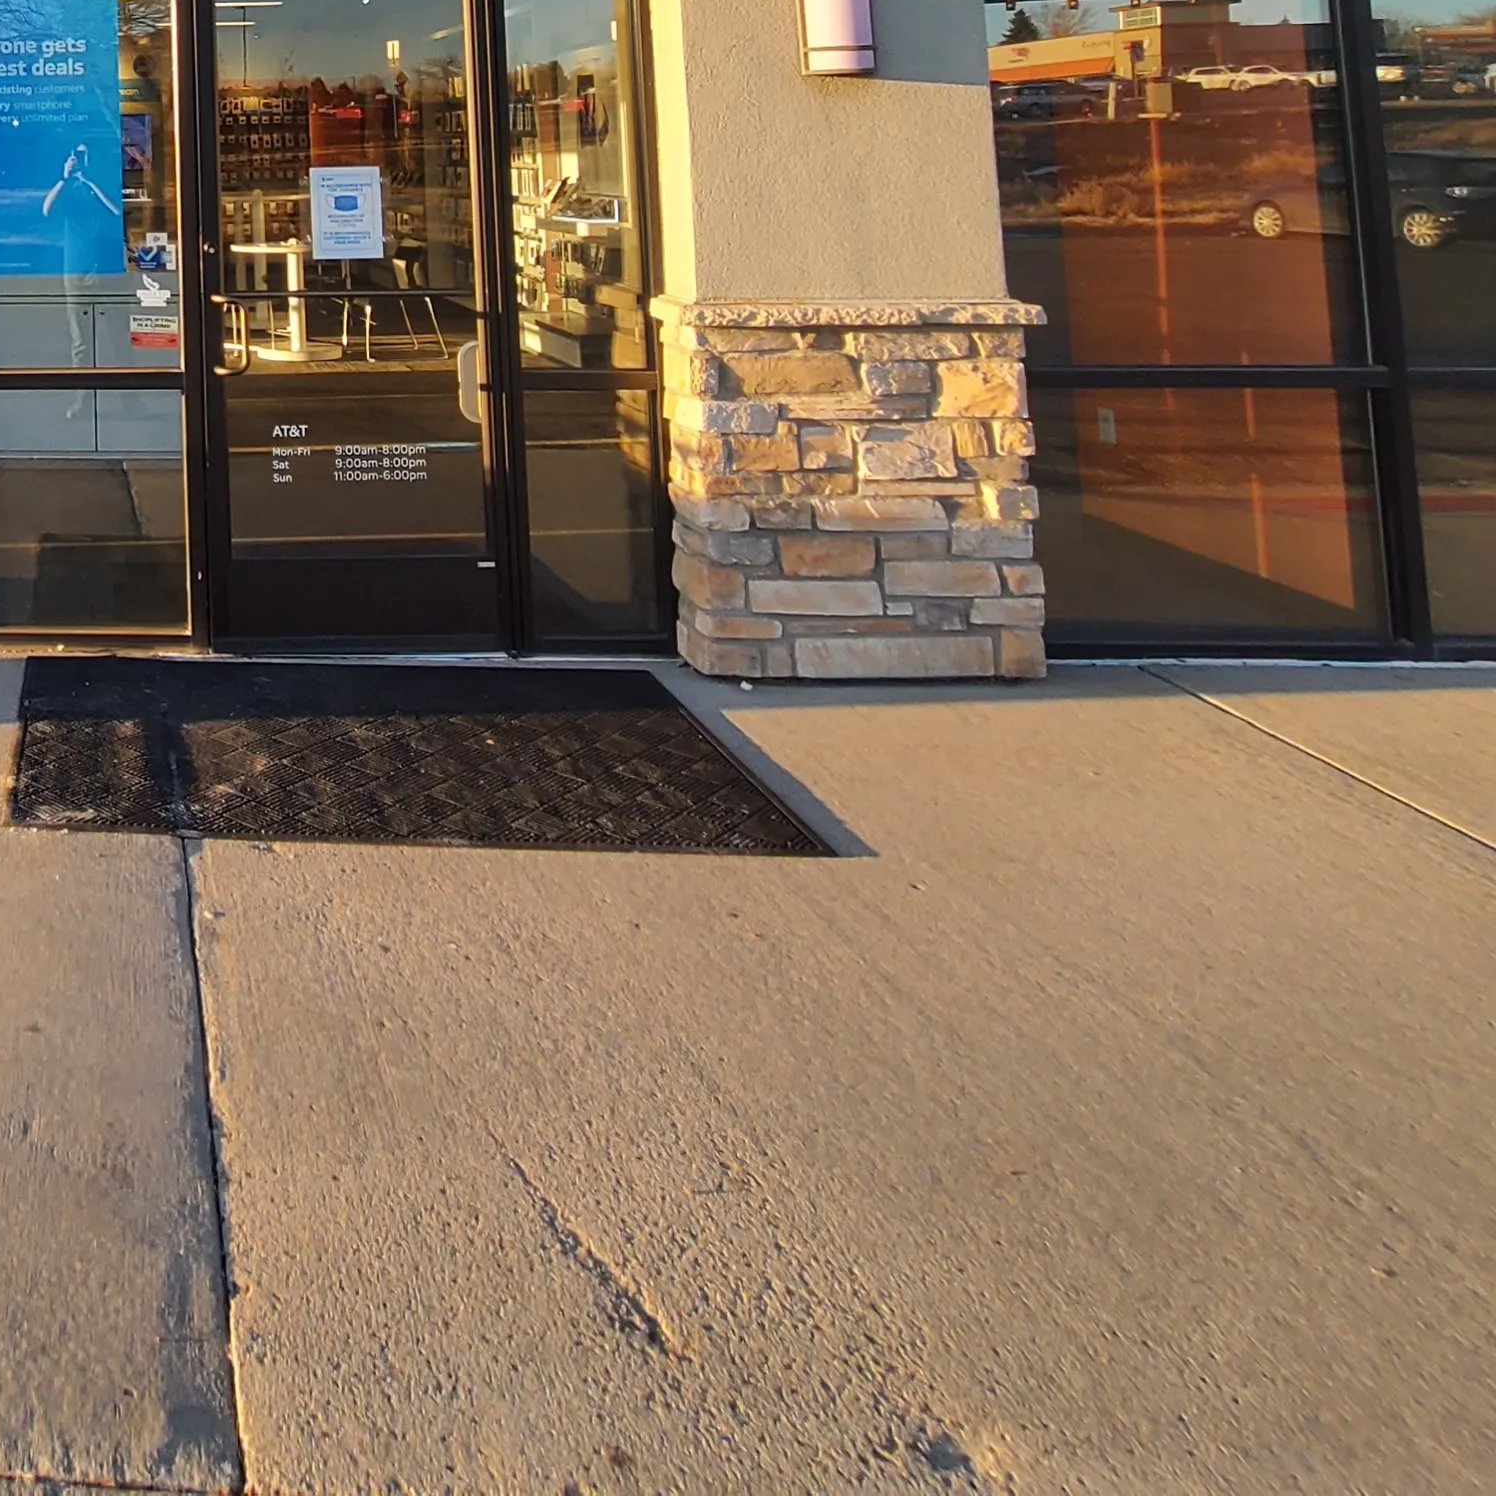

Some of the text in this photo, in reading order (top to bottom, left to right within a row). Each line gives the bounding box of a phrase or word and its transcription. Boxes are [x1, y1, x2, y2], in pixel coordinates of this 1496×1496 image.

[41, 37, 86, 58] gets
[32, 58, 85, 76] deals
[272, 425, 308, 437] AT&T
[272, 445, 426, 457] Mon-Fri 9:00am-8:00pm
[272, 458, 427, 470] Sat 9:00am-8:00pm
[273, 470, 428, 483] Sun 11:00am-6:00pm
